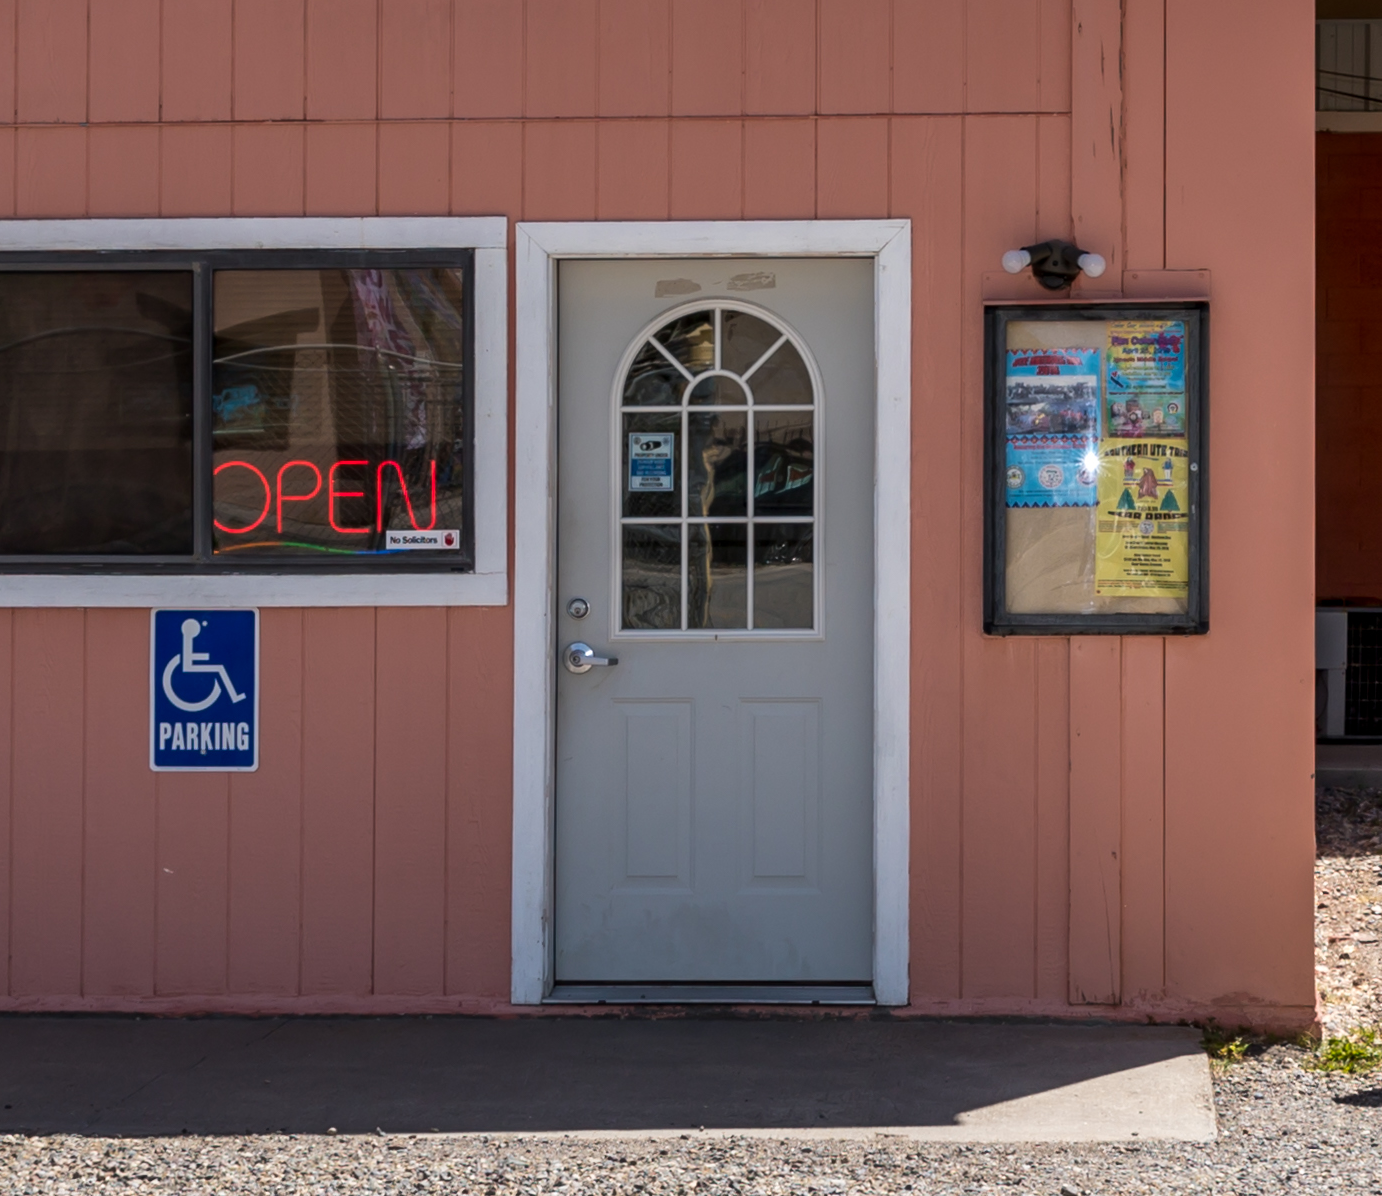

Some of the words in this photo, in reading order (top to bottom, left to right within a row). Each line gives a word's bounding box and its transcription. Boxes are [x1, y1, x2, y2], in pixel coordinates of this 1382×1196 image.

[1150, 444, 1167, 456] UTE
[214, 460, 436, 534] OPEN
[390, 536, 401, 544] No
[402, 535, 438, 545] Solicitors
[159, 722, 249, 751] PARKING
